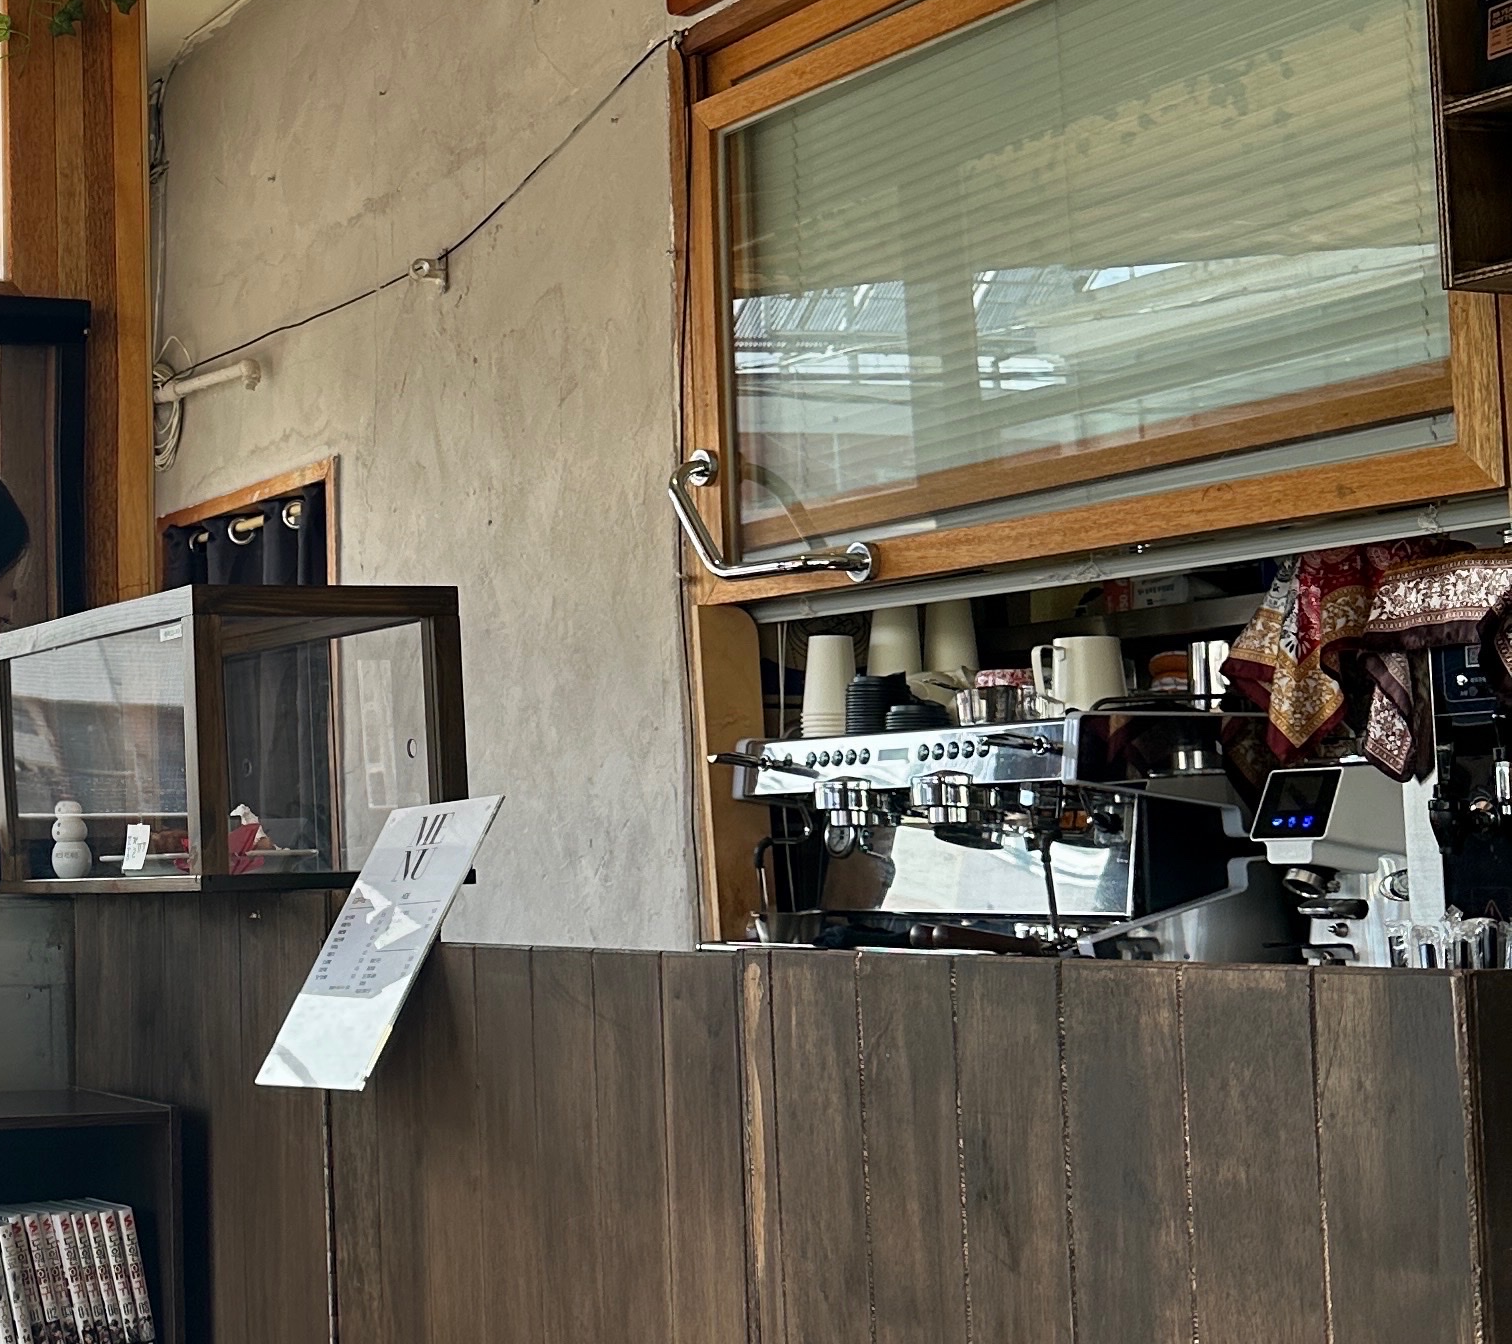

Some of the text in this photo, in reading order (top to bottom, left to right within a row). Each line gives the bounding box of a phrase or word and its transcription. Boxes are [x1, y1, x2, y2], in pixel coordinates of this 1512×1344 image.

[407, 812, 455, 847] ME
[391, 847, 438, 882] NU
[123, 1303, 133, 1314] 07
